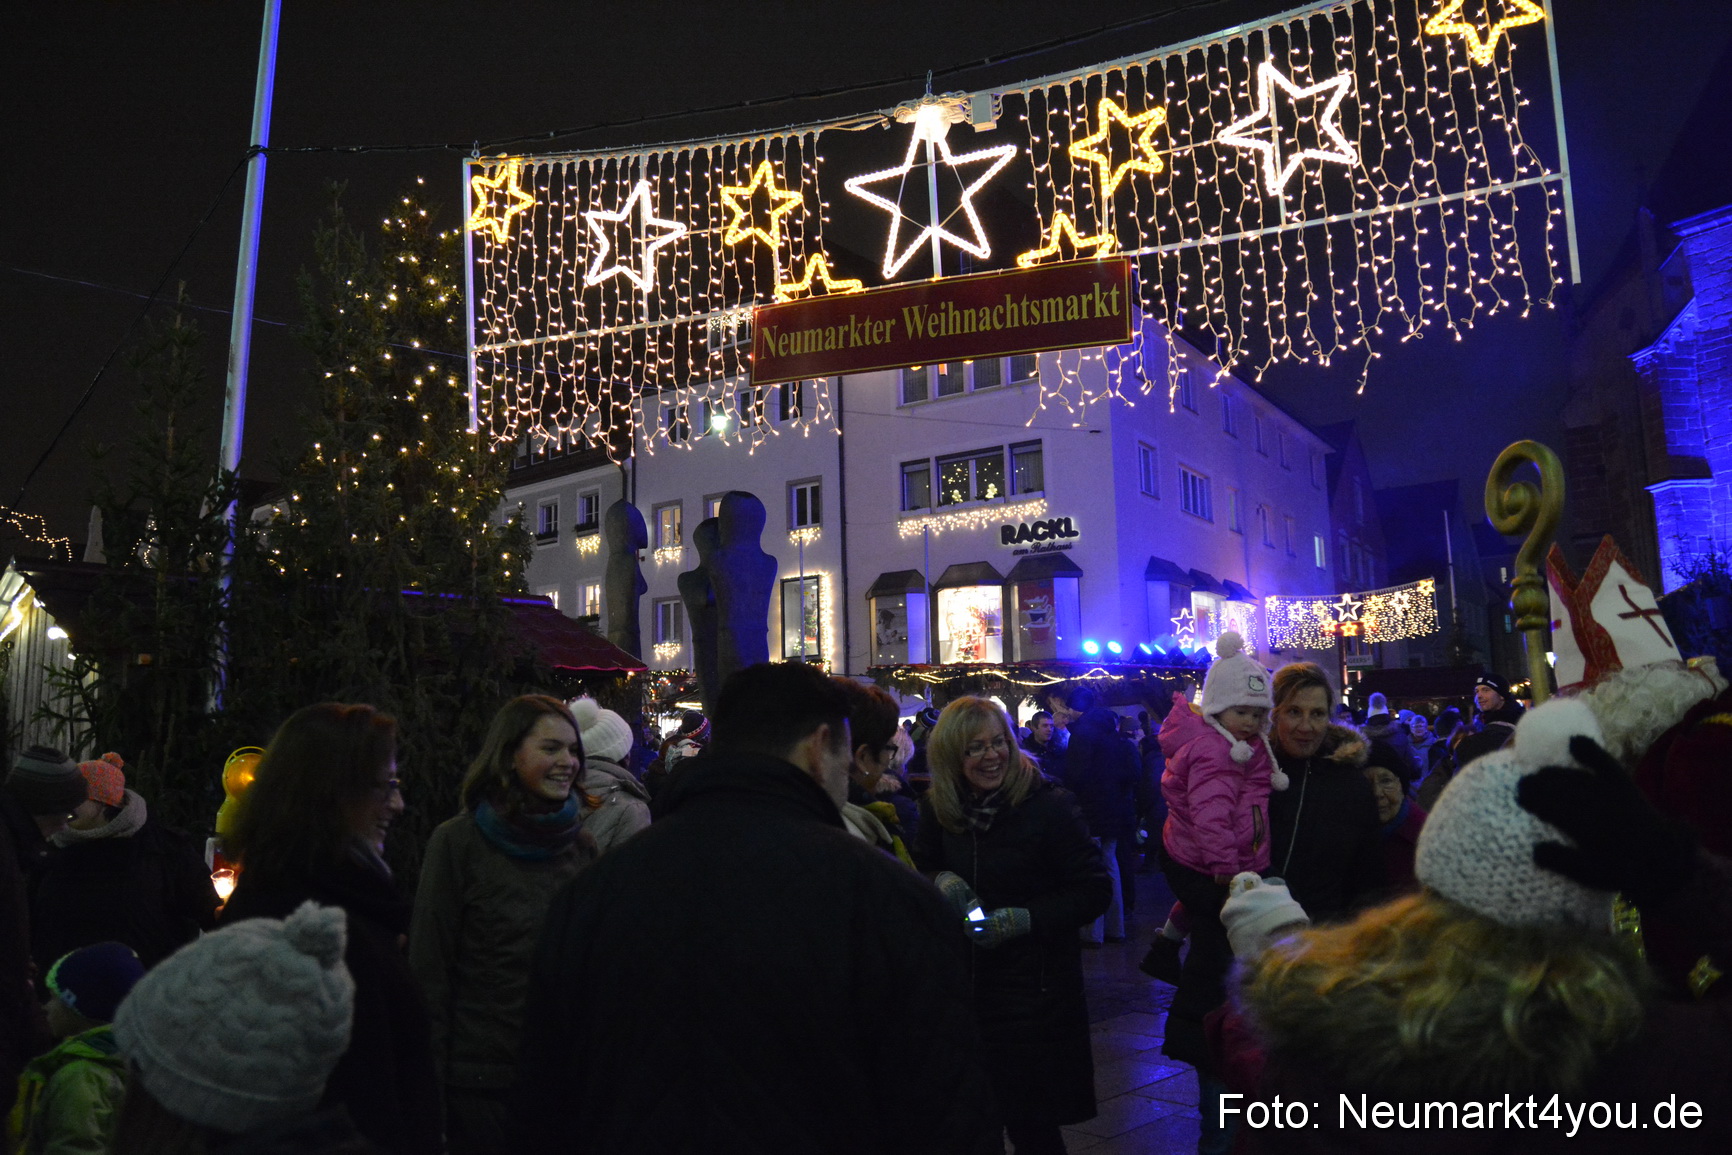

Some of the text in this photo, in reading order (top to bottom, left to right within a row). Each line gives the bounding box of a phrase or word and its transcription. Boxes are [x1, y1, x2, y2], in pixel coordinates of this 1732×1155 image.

[760, 282, 1121, 360] Neumarkter Weihnachtsmarkt
[1001, 516, 1080, 545] RACKL
[1030, 541, 1073, 554] Rathaus
